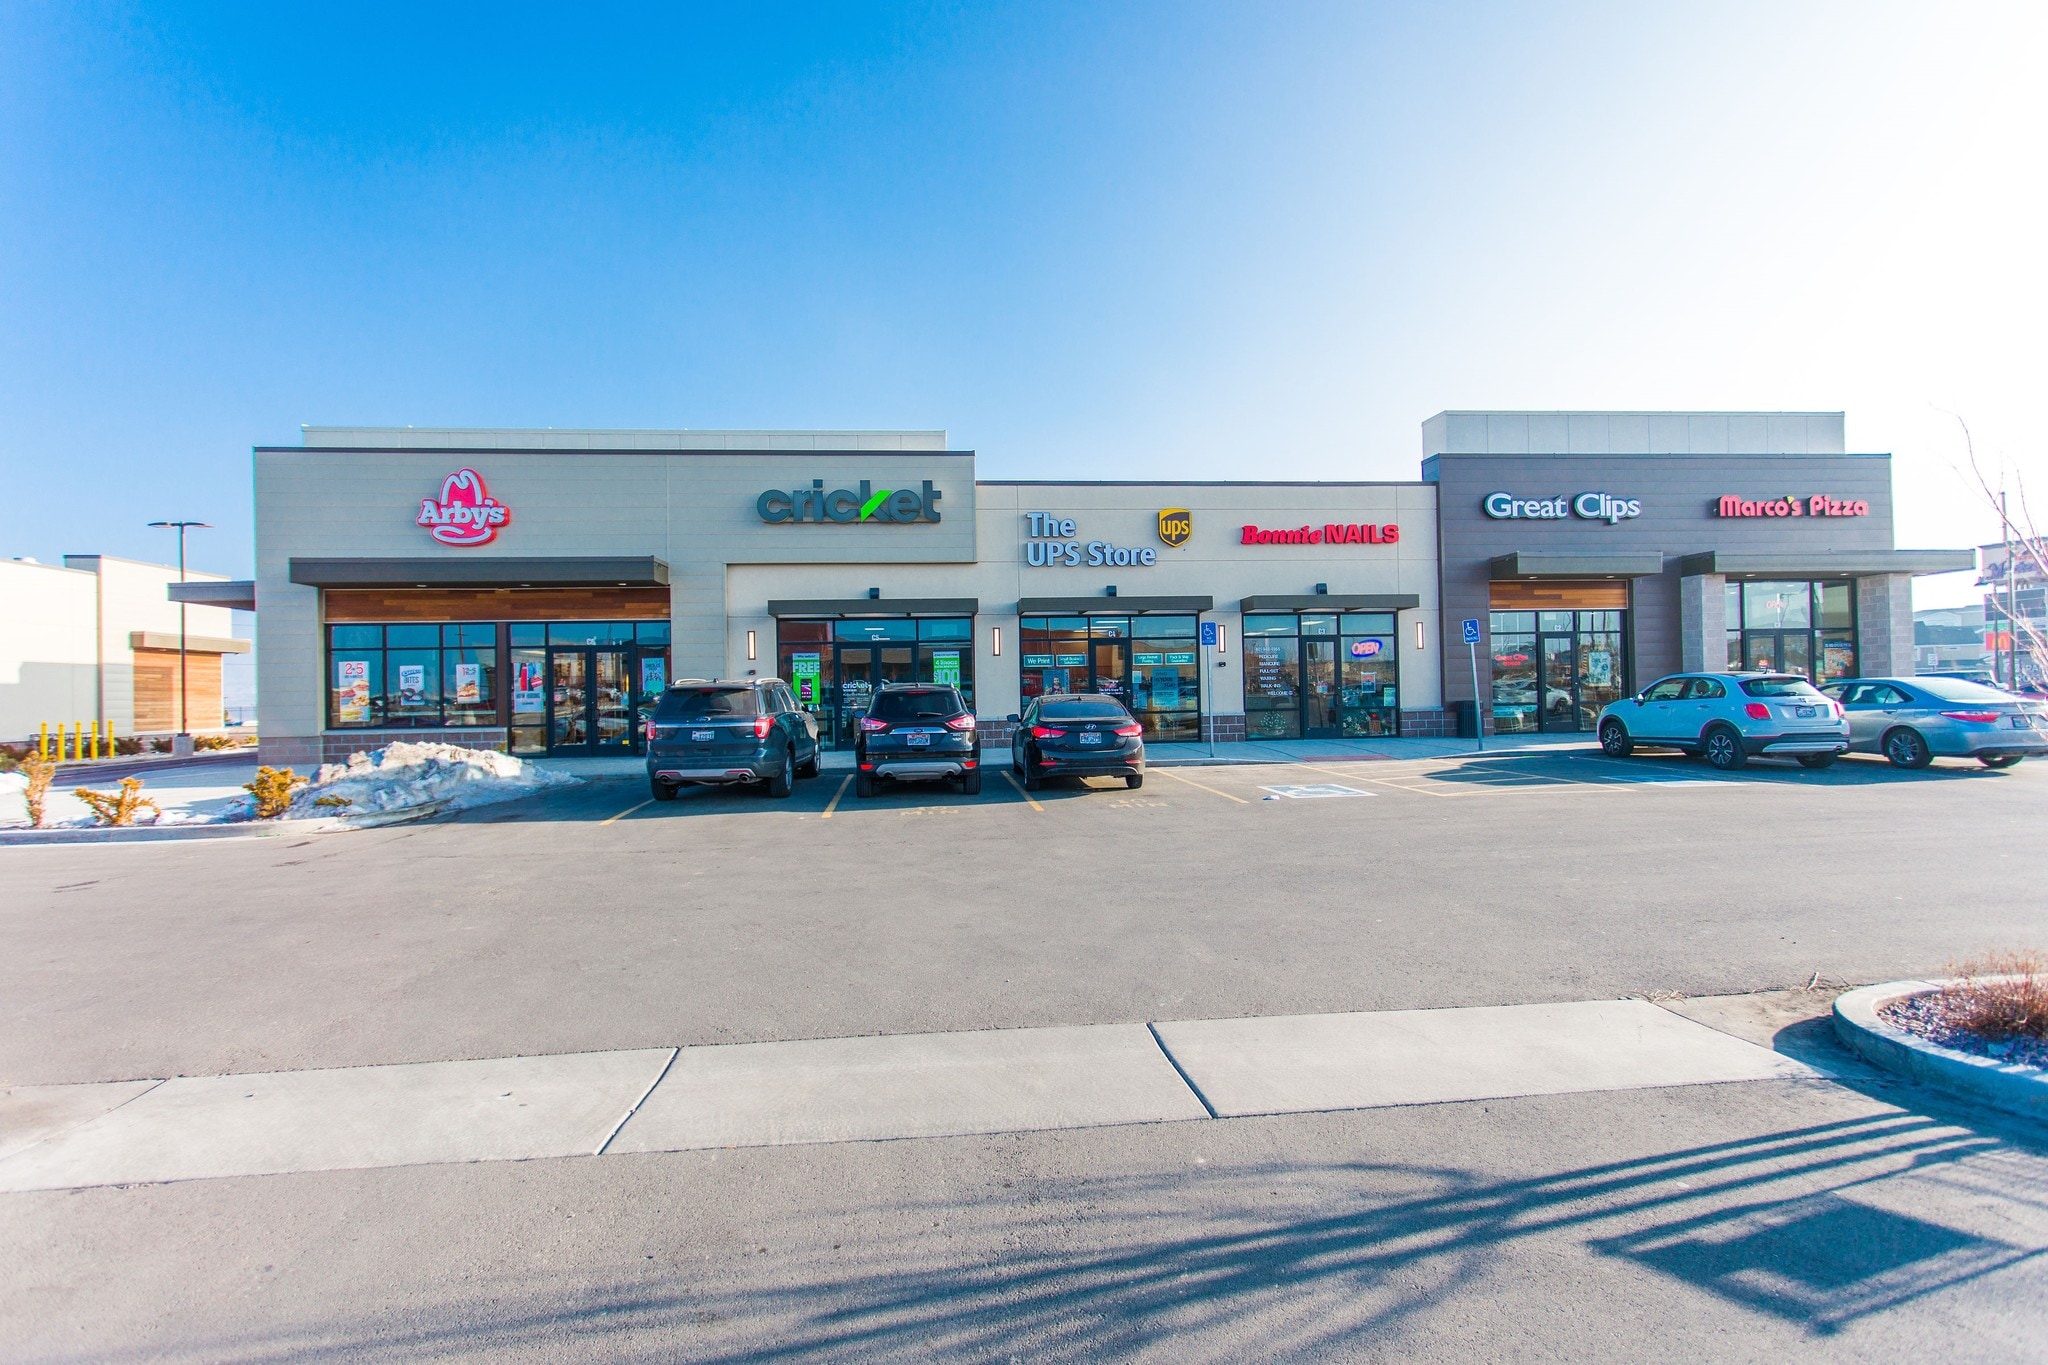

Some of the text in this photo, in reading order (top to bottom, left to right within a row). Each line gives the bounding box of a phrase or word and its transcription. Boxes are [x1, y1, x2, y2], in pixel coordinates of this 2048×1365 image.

[757, 479, 942, 523] cricket
[1485, 492, 1641, 524] Great Clips
[1719, 495, 1869, 517] Marco's Pizza
[418, 500, 506, 530] Arby's
[1026, 512, 1077, 538] The
[1162, 520, 1190, 541] ups
[1241, 524, 1399, 545] Bonnie NAILS
[1026, 541, 1156, 567] UPS Store
[1352, 642, 1380, 655] OPEN
[793, 662, 820, 672] FREE
